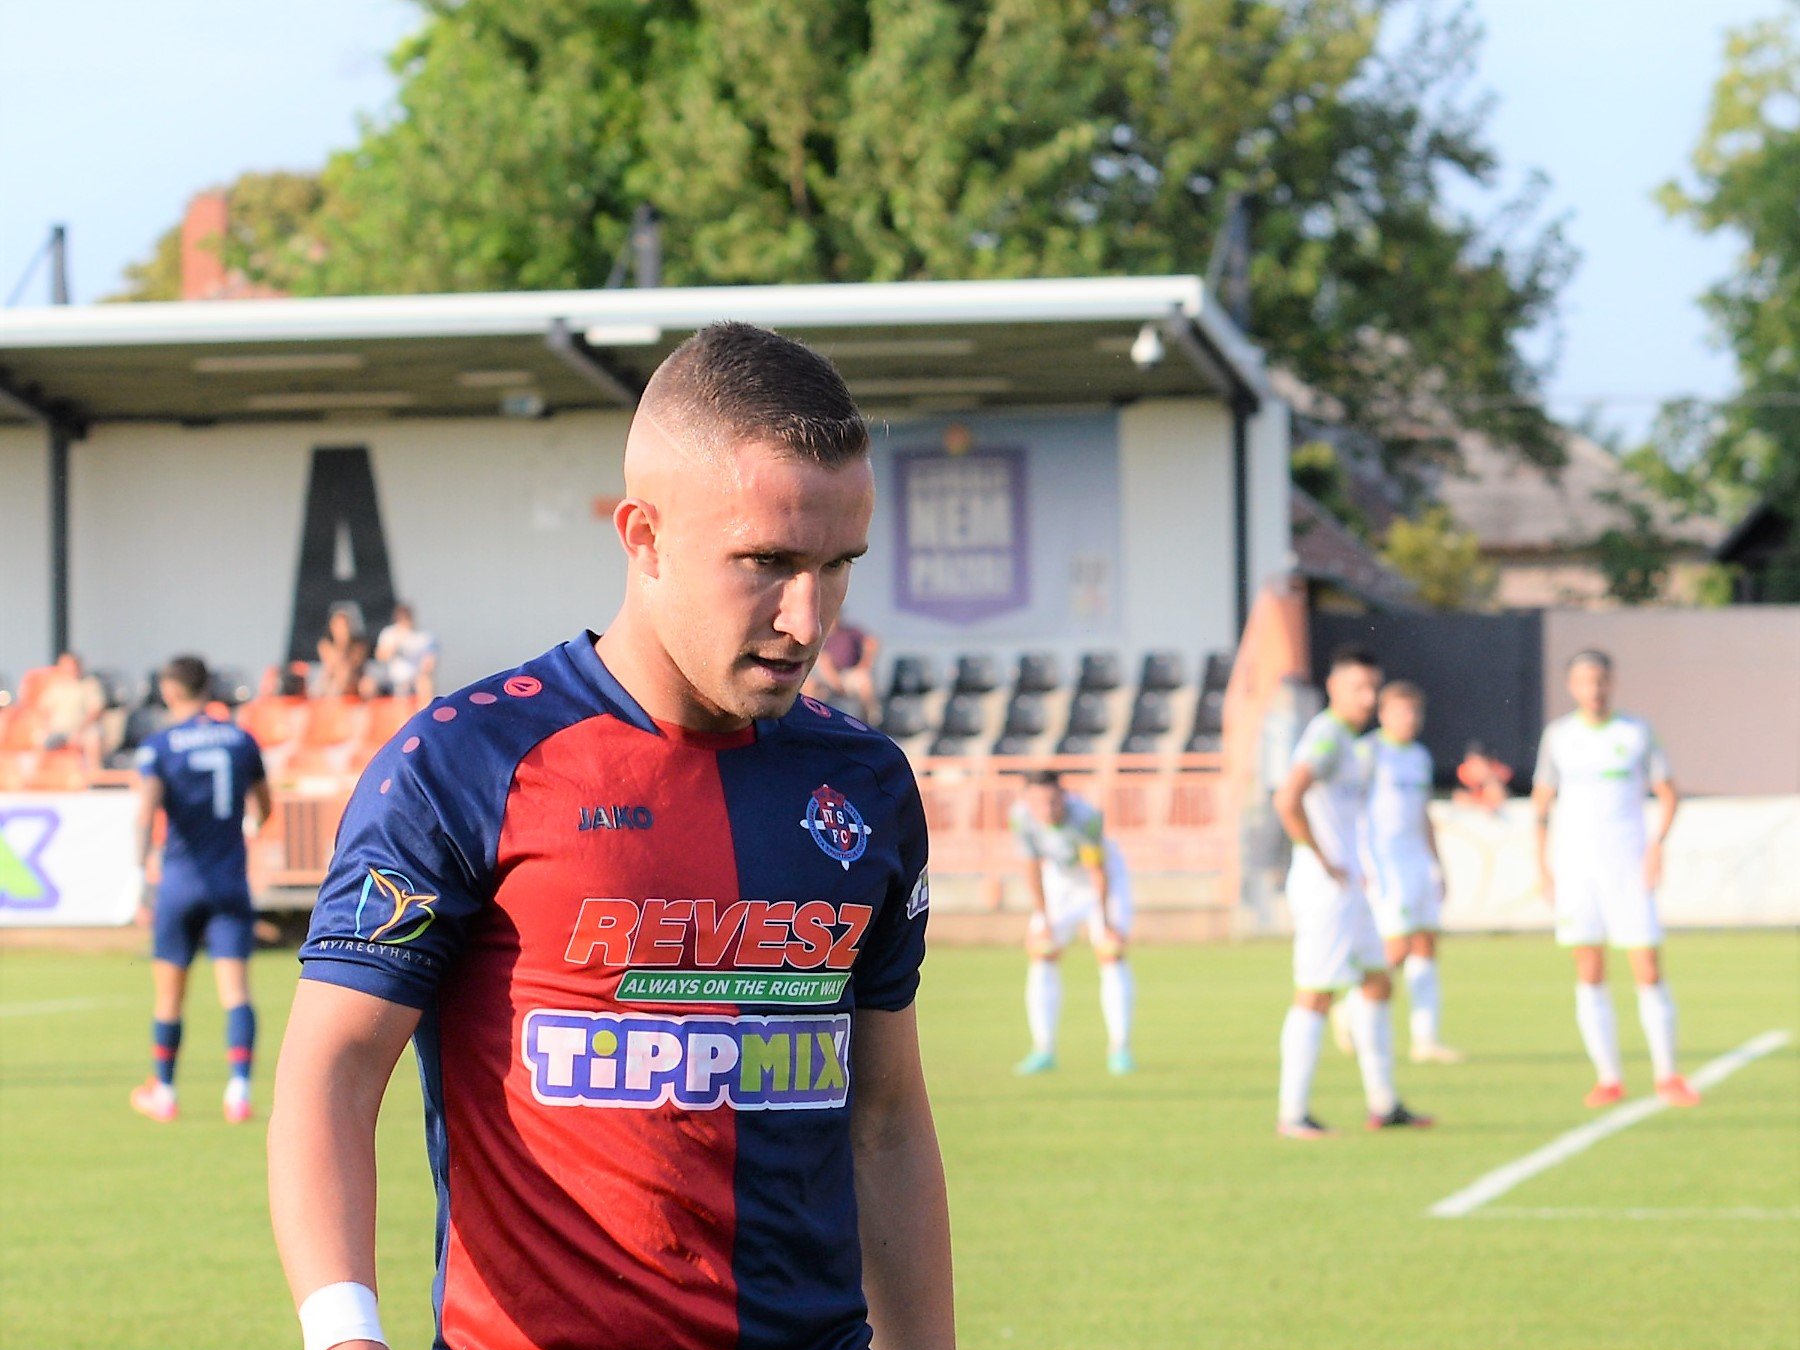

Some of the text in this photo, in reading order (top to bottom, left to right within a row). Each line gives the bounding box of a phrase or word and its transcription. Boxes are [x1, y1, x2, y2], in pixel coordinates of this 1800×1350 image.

[283, 445, 402, 692] A
[188, 749, 233, 819] 7
[577, 806, 655, 830] JAKO
[624, 979, 844, 997] ALWAYS ON THE RIGHT WAY
